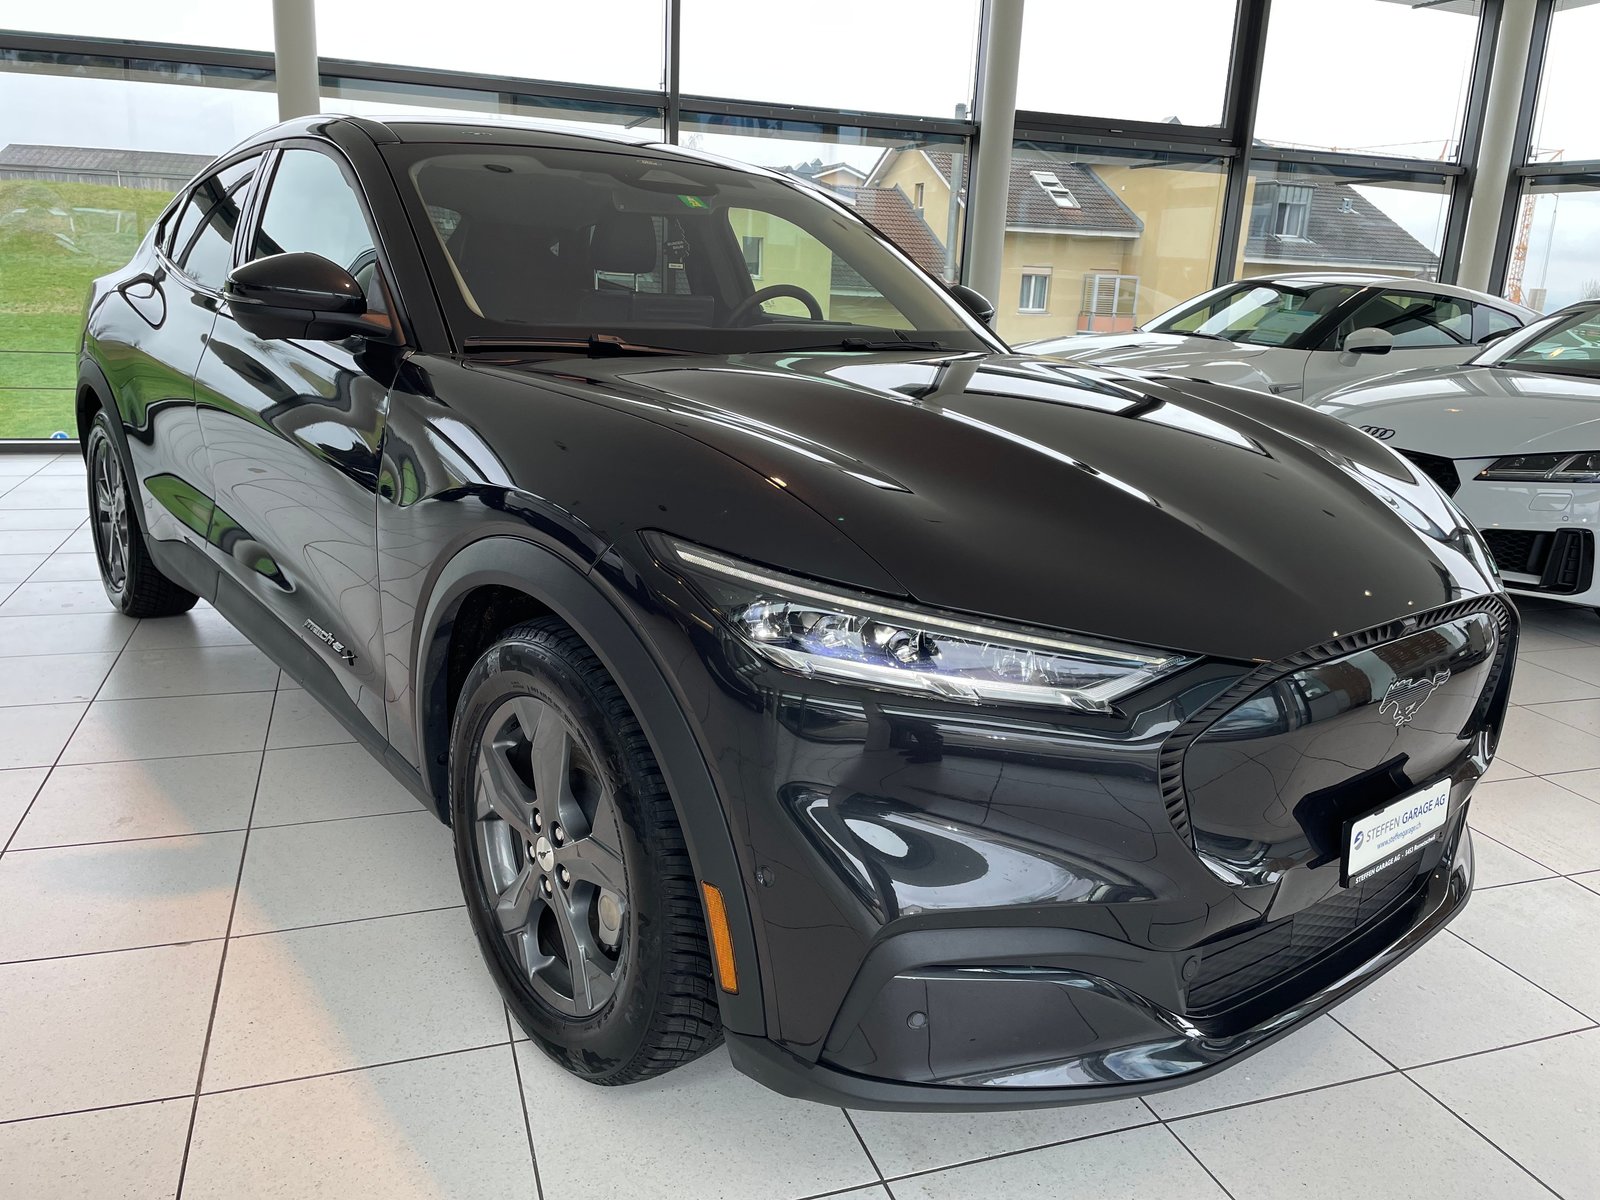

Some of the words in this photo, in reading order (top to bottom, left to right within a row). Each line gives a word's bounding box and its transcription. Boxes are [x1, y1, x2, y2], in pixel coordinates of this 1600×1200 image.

[1366, 815, 1401, 843] STEFFEN
[1401, 799, 1434, 825] GARAGE
[1433, 793, 1446, 809] AG
[1376, 822, 1422, 850] www.steffengarage.ch
[1355, 867, 1376, 884] STEFFEN
[1375, 857, 1394, 872] GARAGE
[1392, 854, 1401, 863] AG
